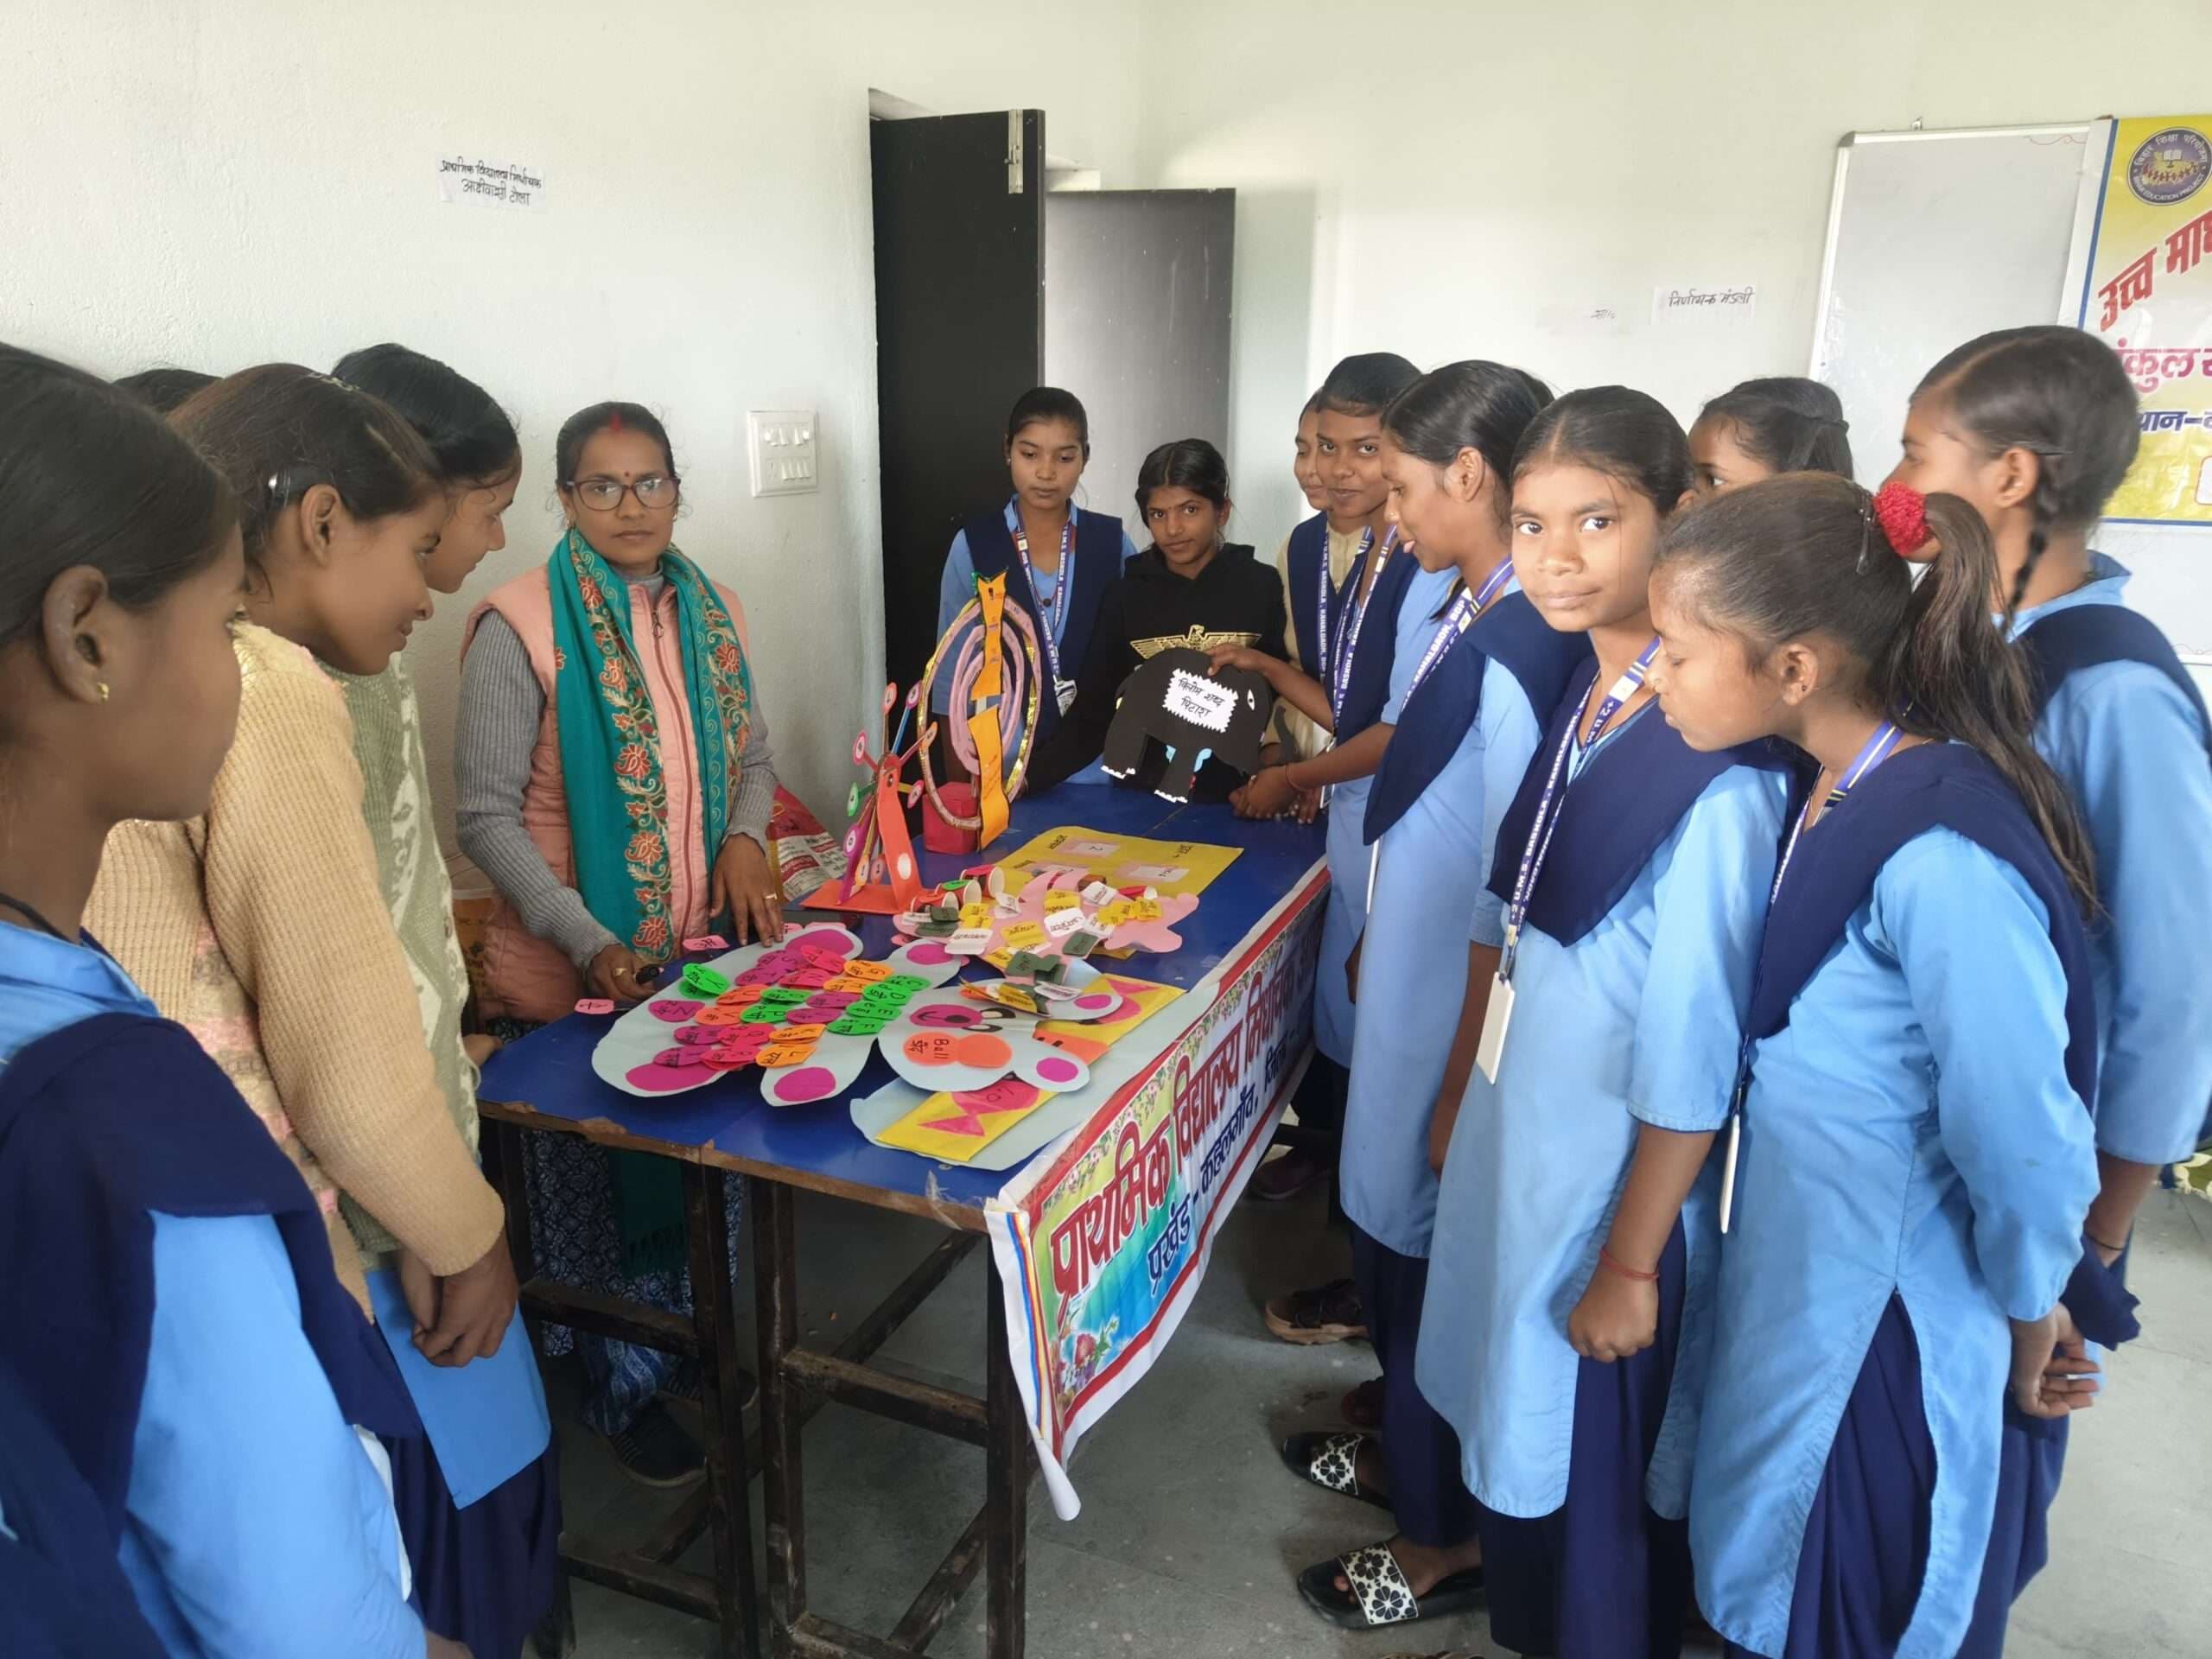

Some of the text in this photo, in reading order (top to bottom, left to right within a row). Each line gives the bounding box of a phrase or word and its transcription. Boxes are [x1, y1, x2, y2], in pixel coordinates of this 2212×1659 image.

[933, 1038, 950, 1059] Ball
[1050, 1121, 1172, 1332] प्राथमिक
[1173, 1054, 1244, 1176] विद्यालय
[1147, 1194, 1192, 1295] प्रखंड
